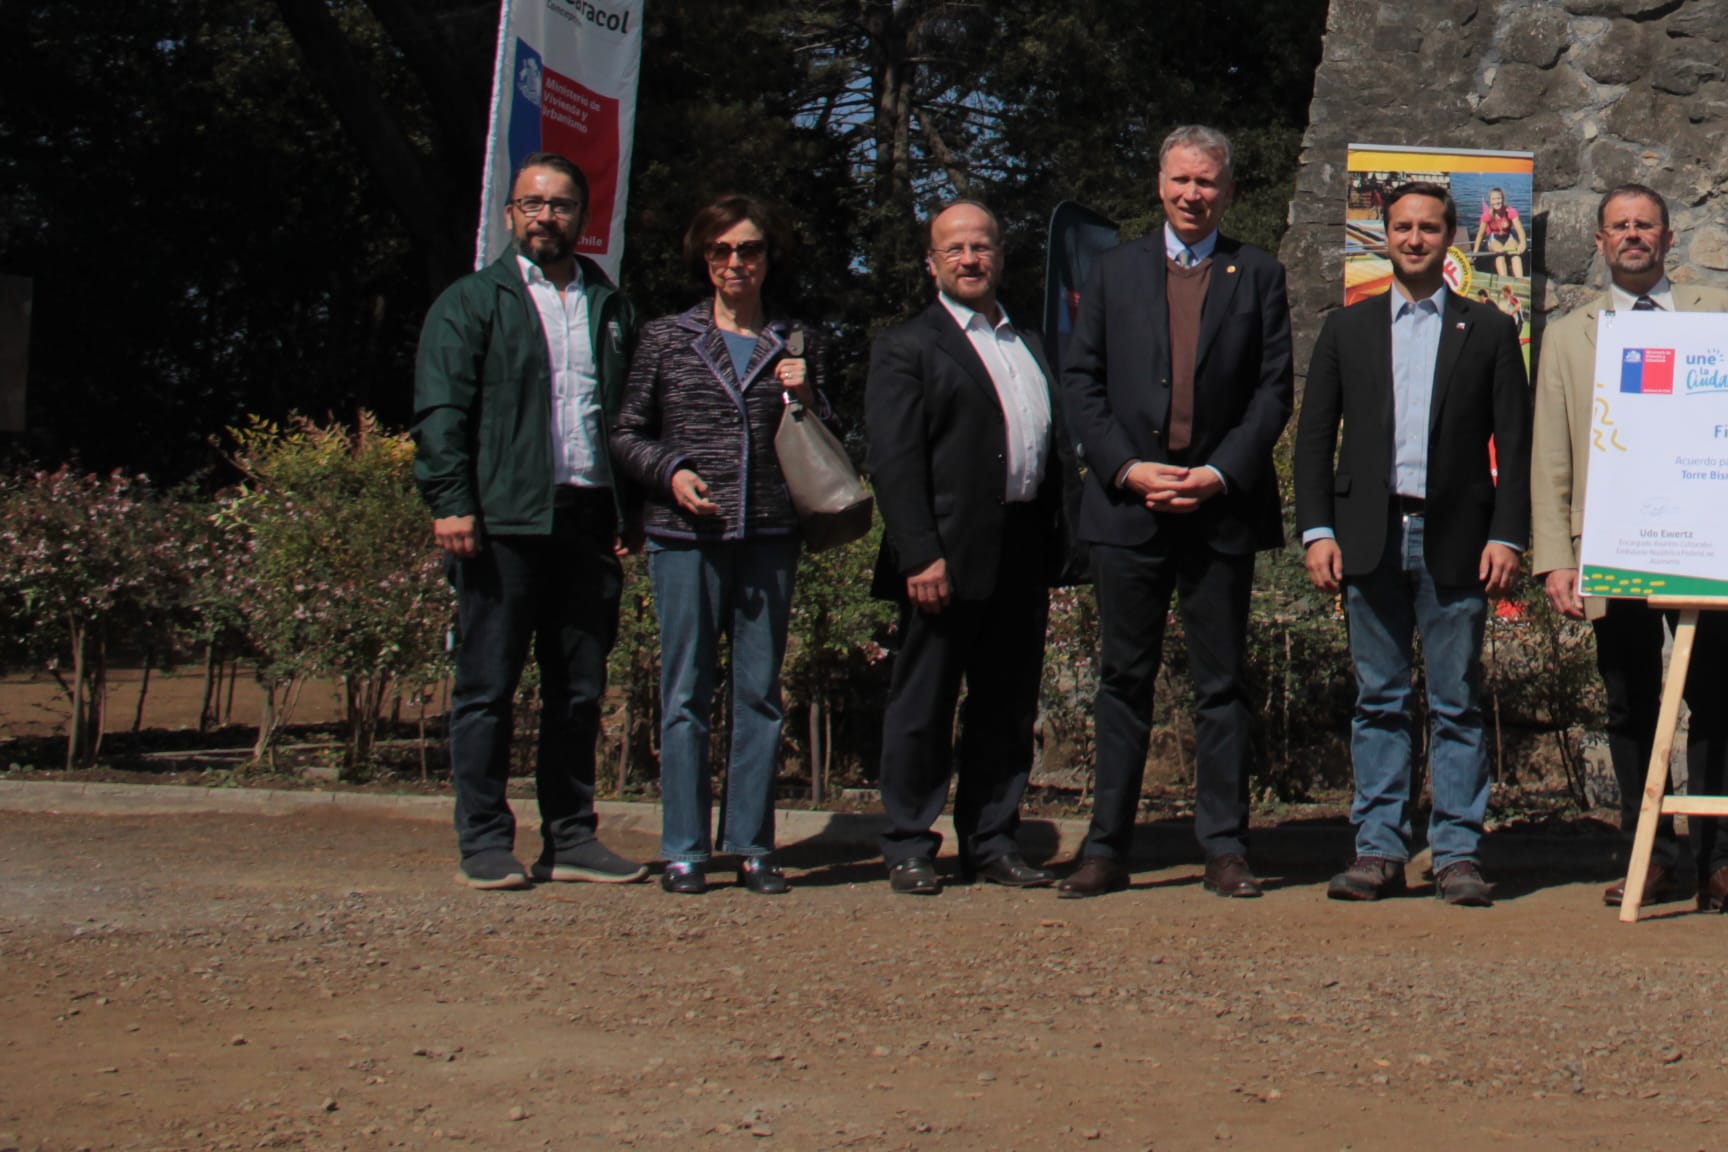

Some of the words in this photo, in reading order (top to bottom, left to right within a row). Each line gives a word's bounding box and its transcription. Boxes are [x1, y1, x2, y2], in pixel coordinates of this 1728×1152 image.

[1686, 354, 1716, 366] une
[1674, 456, 1717, 466] Acuerdo
[1681, 470, 1707, 480] Torre
[1640, 529, 1658, 538] Udo
